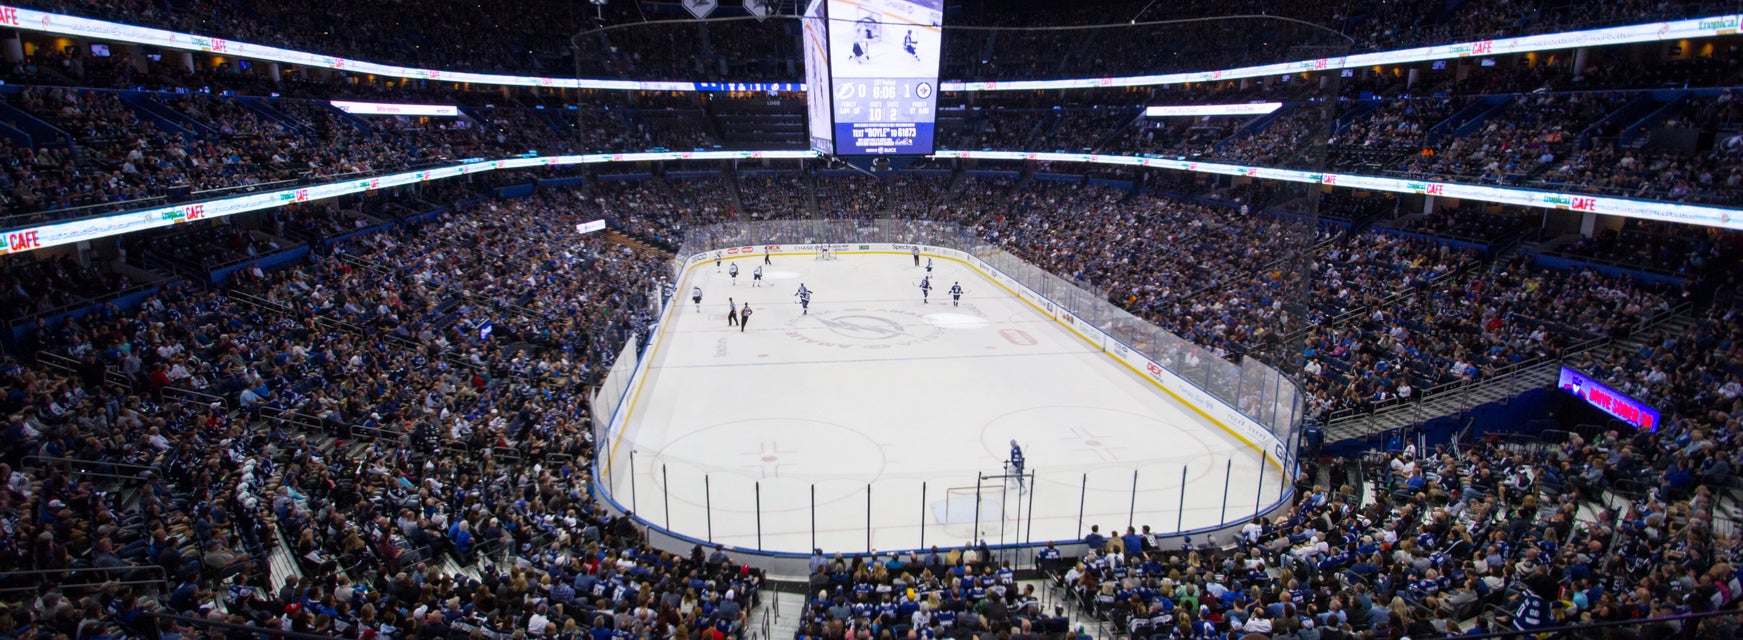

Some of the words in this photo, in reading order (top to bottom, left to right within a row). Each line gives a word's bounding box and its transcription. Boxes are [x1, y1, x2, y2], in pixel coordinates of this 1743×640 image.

[211, 39, 227, 52] CAFE
[1472, 40, 1493, 54] CAFE
[1315, 58, 1328, 69] CAFE
[858, 84, 866, 97] 0
[904, 84, 910, 97] 1
[869, 109, 882, 121] 10
[890, 109, 897, 121] 2
[1324, 173, 1336, 184] CAFE
[296, 189, 309, 201] CAFE
[1426, 183, 1444, 195] CAFE
[1572, 197, 1597, 211] CAFE
[185, 205, 205, 220] CAFE
[9, 230, 40, 251] CAFE
[1146, 362, 1163, 377] DEX
